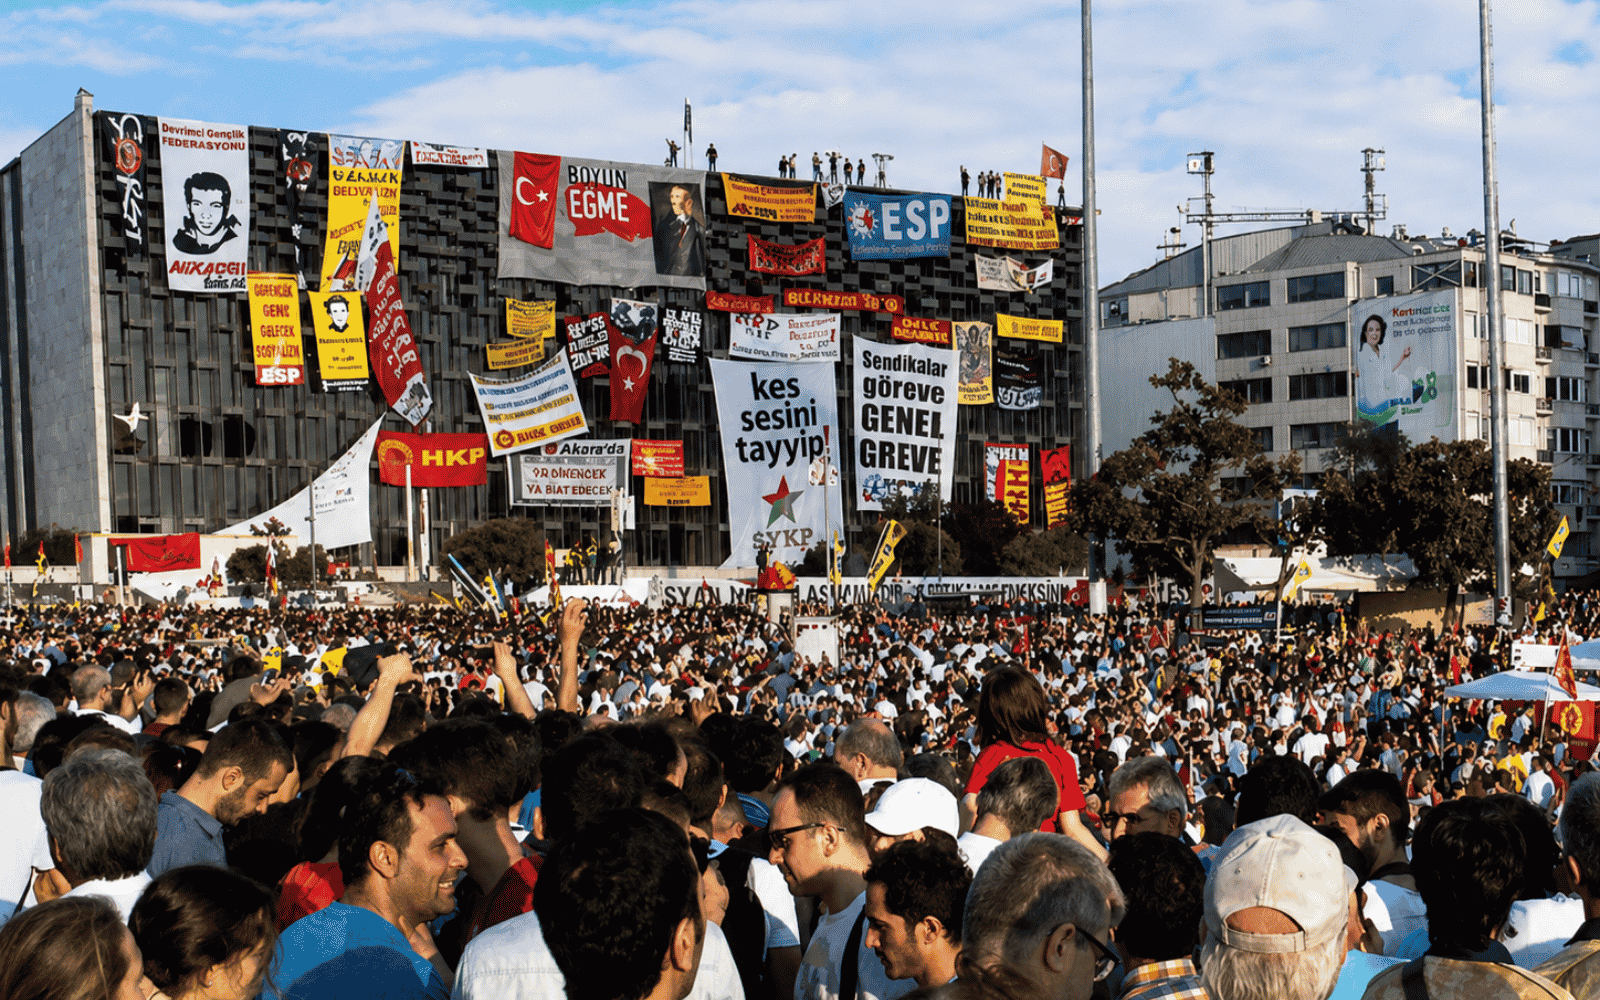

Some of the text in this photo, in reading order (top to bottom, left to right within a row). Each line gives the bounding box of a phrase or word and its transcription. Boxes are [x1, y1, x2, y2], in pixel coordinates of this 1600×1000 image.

[162, 122, 205, 138] Devrimci
[162, 136, 246, 151] FEDERASYONU
[568, 164, 627, 190] BOYUN
[882, 198, 950, 241] ESP
[260, 366, 301, 384] ESP
[862, 350, 948, 378] Sendikalar
[751, 371, 801, 401] kes
[863, 374, 946, 405] göreve
[741, 397, 817, 432] sesini
[861, 402, 945, 440] GENEL
[422, 447, 485, 467] HKP
[859, 438, 943, 475] GREVE
[527, 484, 543, 495] YA
[660, 581, 721, 607] SYAN
